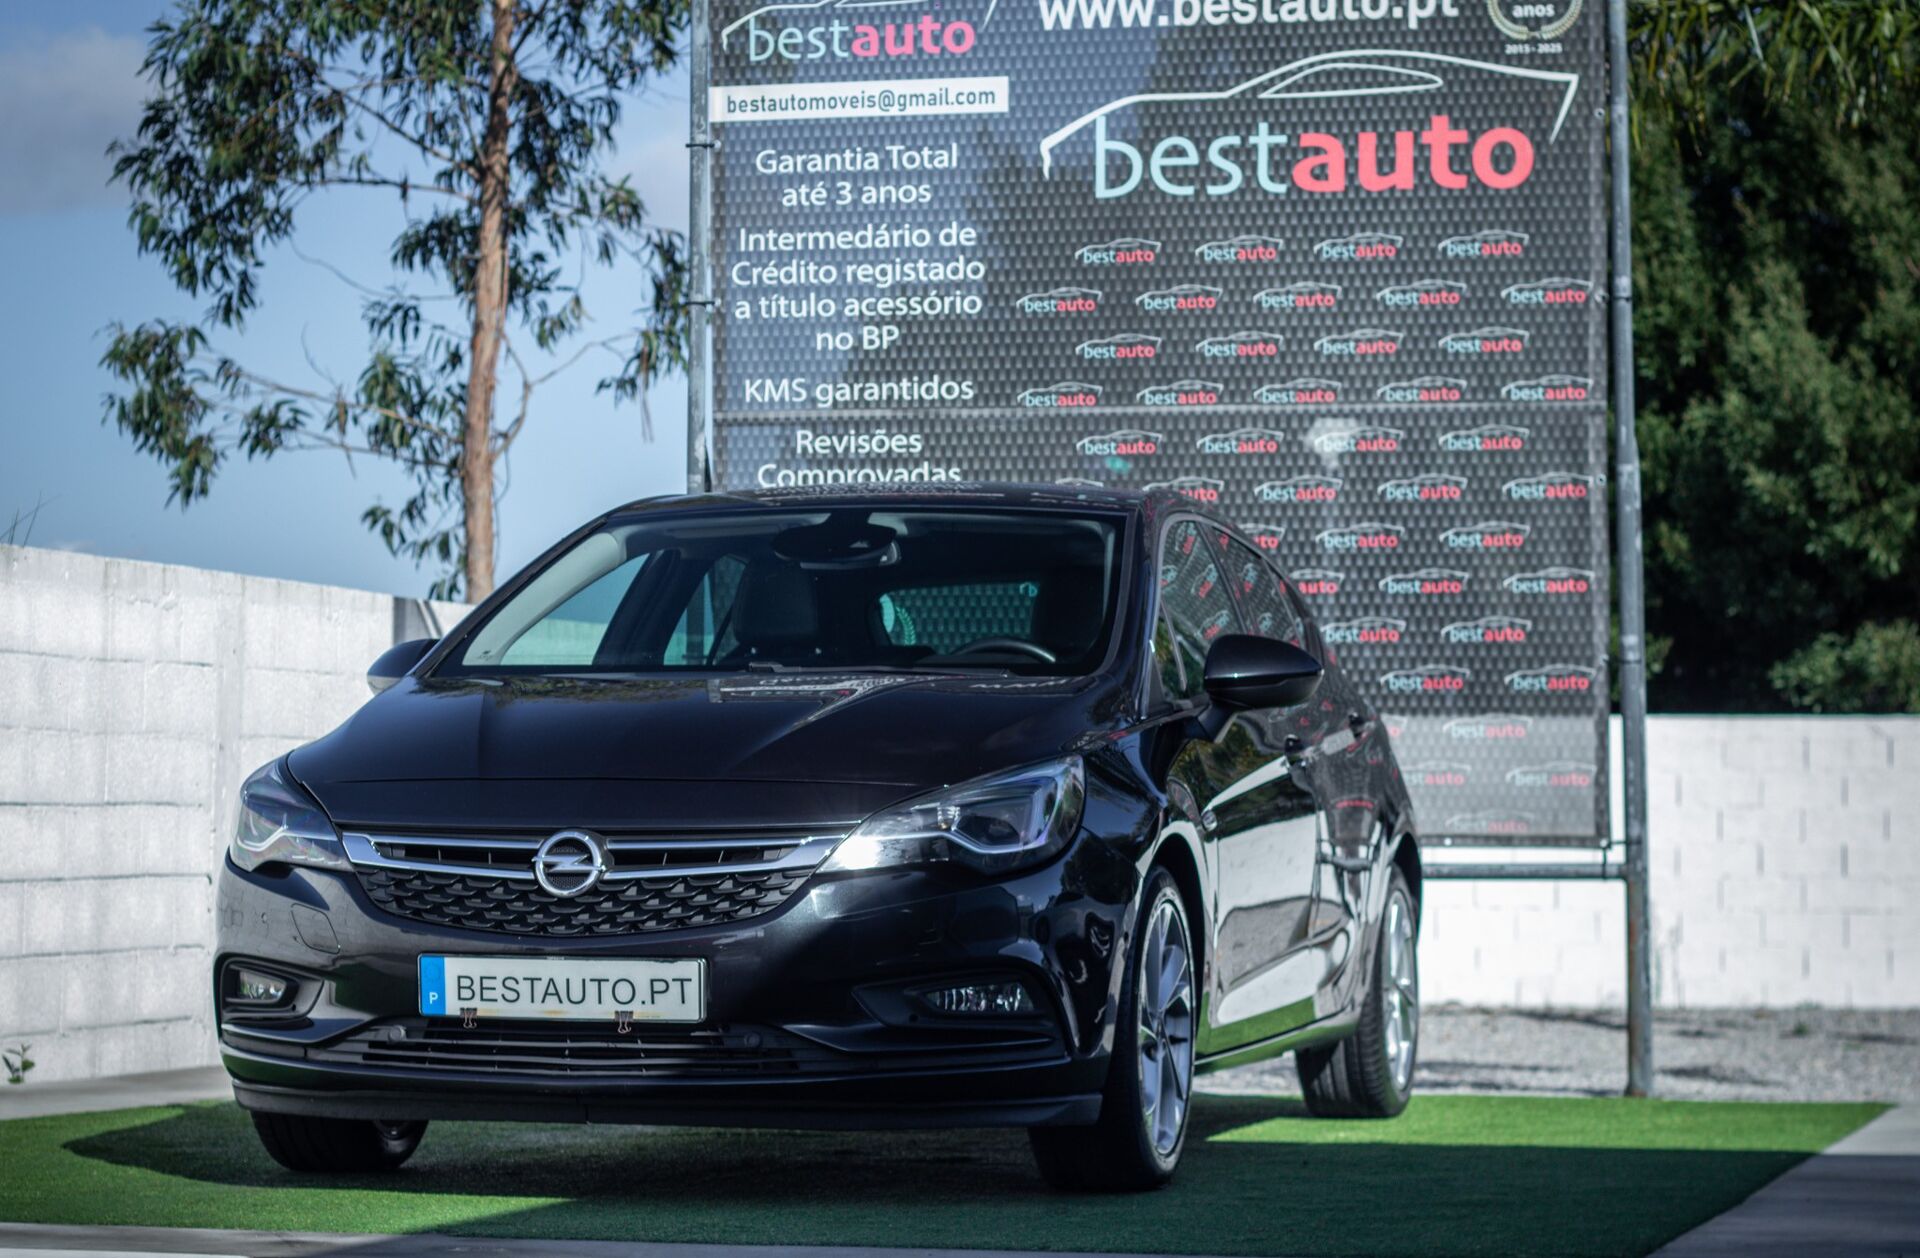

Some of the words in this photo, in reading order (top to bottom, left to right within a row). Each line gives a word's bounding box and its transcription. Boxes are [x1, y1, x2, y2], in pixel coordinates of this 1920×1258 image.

[1038, 0, 1460, 31] www.bestauto.pt
[1511, 3, 1555, 18] anos
[749, 13, 976, 62] bestauto
[727, 87, 996, 114] bestautomoveis@gmail.com
[756, 147, 880, 174] Garantia
[886, 142, 958, 169] Total
[1095, 115, 1535, 198] bestauto
[782, 182, 827, 207] até
[835, 182, 853, 205] 3
[861, 183, 932, 205] anos
[740, 223, 931, 252] Intermedário
[939, 221, 977, 246] de
[1082, 248, 1155, 265] bestauto
[1203, 246, 1277, 261] bestauto
[1321, 244, 1397, 259] bestauto
[1446, 241, 1522, 257] bestauto
[731, 260, 838, 286] Crédito
[846, 255, 986, 288] registado
[734, 301, 750, 319] a
[759, 293, 836, 318] título
[844, 290, 983, 316] acessório
[1143, 294, 1217, 311] bestauto
[1261, 292, 1335, 307] bestauto
[1385, 292, 1461, 307] bestauto
[1509, 289, 1586, 305] bestauto
[1023, 298, 1097, 313] bestauto
[816, 330, 853, 351] no
[862, 326, 900, 350] BP
[1446, 339, 1522, 354] bestauto
[1083, 343, 1156, 360] bestauto
[1203, 341, 1277, 357] bestauto
[1321, 341, 1397, 356] bestauto
[745, 377, 807, 403] KMS
[815, 375, 975, 408] garantidos
[1144, 390, 1217, 406] bestauto
[1261, 388, 1336, 404] bestauto
[1385, 388, 1461, 403] bestauto
[1509, 387, 1586, 402] bestauto
[1025, 392, 1097, 408] bestauto
[796, 429, 923, 454] Revisões
[1084, 439, 1157, 455] bestauto
[1204, 438, 1278, 453] bestauto
[1322, 438, 1397, 453] bestauto
[1446, 436, 1523, 451] bestauto
[758, 462, 961, 489] Comprovadas
[1263, 485, 1336, 500] bestauto
[1385, 486, 1461, 500] bestauto
[1510, 483, 1587, 499] bestauto
[1323, 534, 1399, 550] bestauto
[1447, 532, 1524, 548] bestauto
[1386, 580, 1462, 595] bestauto
[1511, 579, 1588, 594] bestauto
[1324, 628, 1400, 644] bestauto
[1449, 627, 1525, 642] bestauto
[1388, 675, 1465, 691] bestauto
[1512, 675, 1589, 691] bestauto
[1450, 723, 1526, 739] bestauto
[1514, 771, 1590, 787] bestauto
[1451, 819, 1526, 835] bestauto
[429, 992, 439, 1004] P
[456, 975, 692, 1005] BESTAUTO.PT
